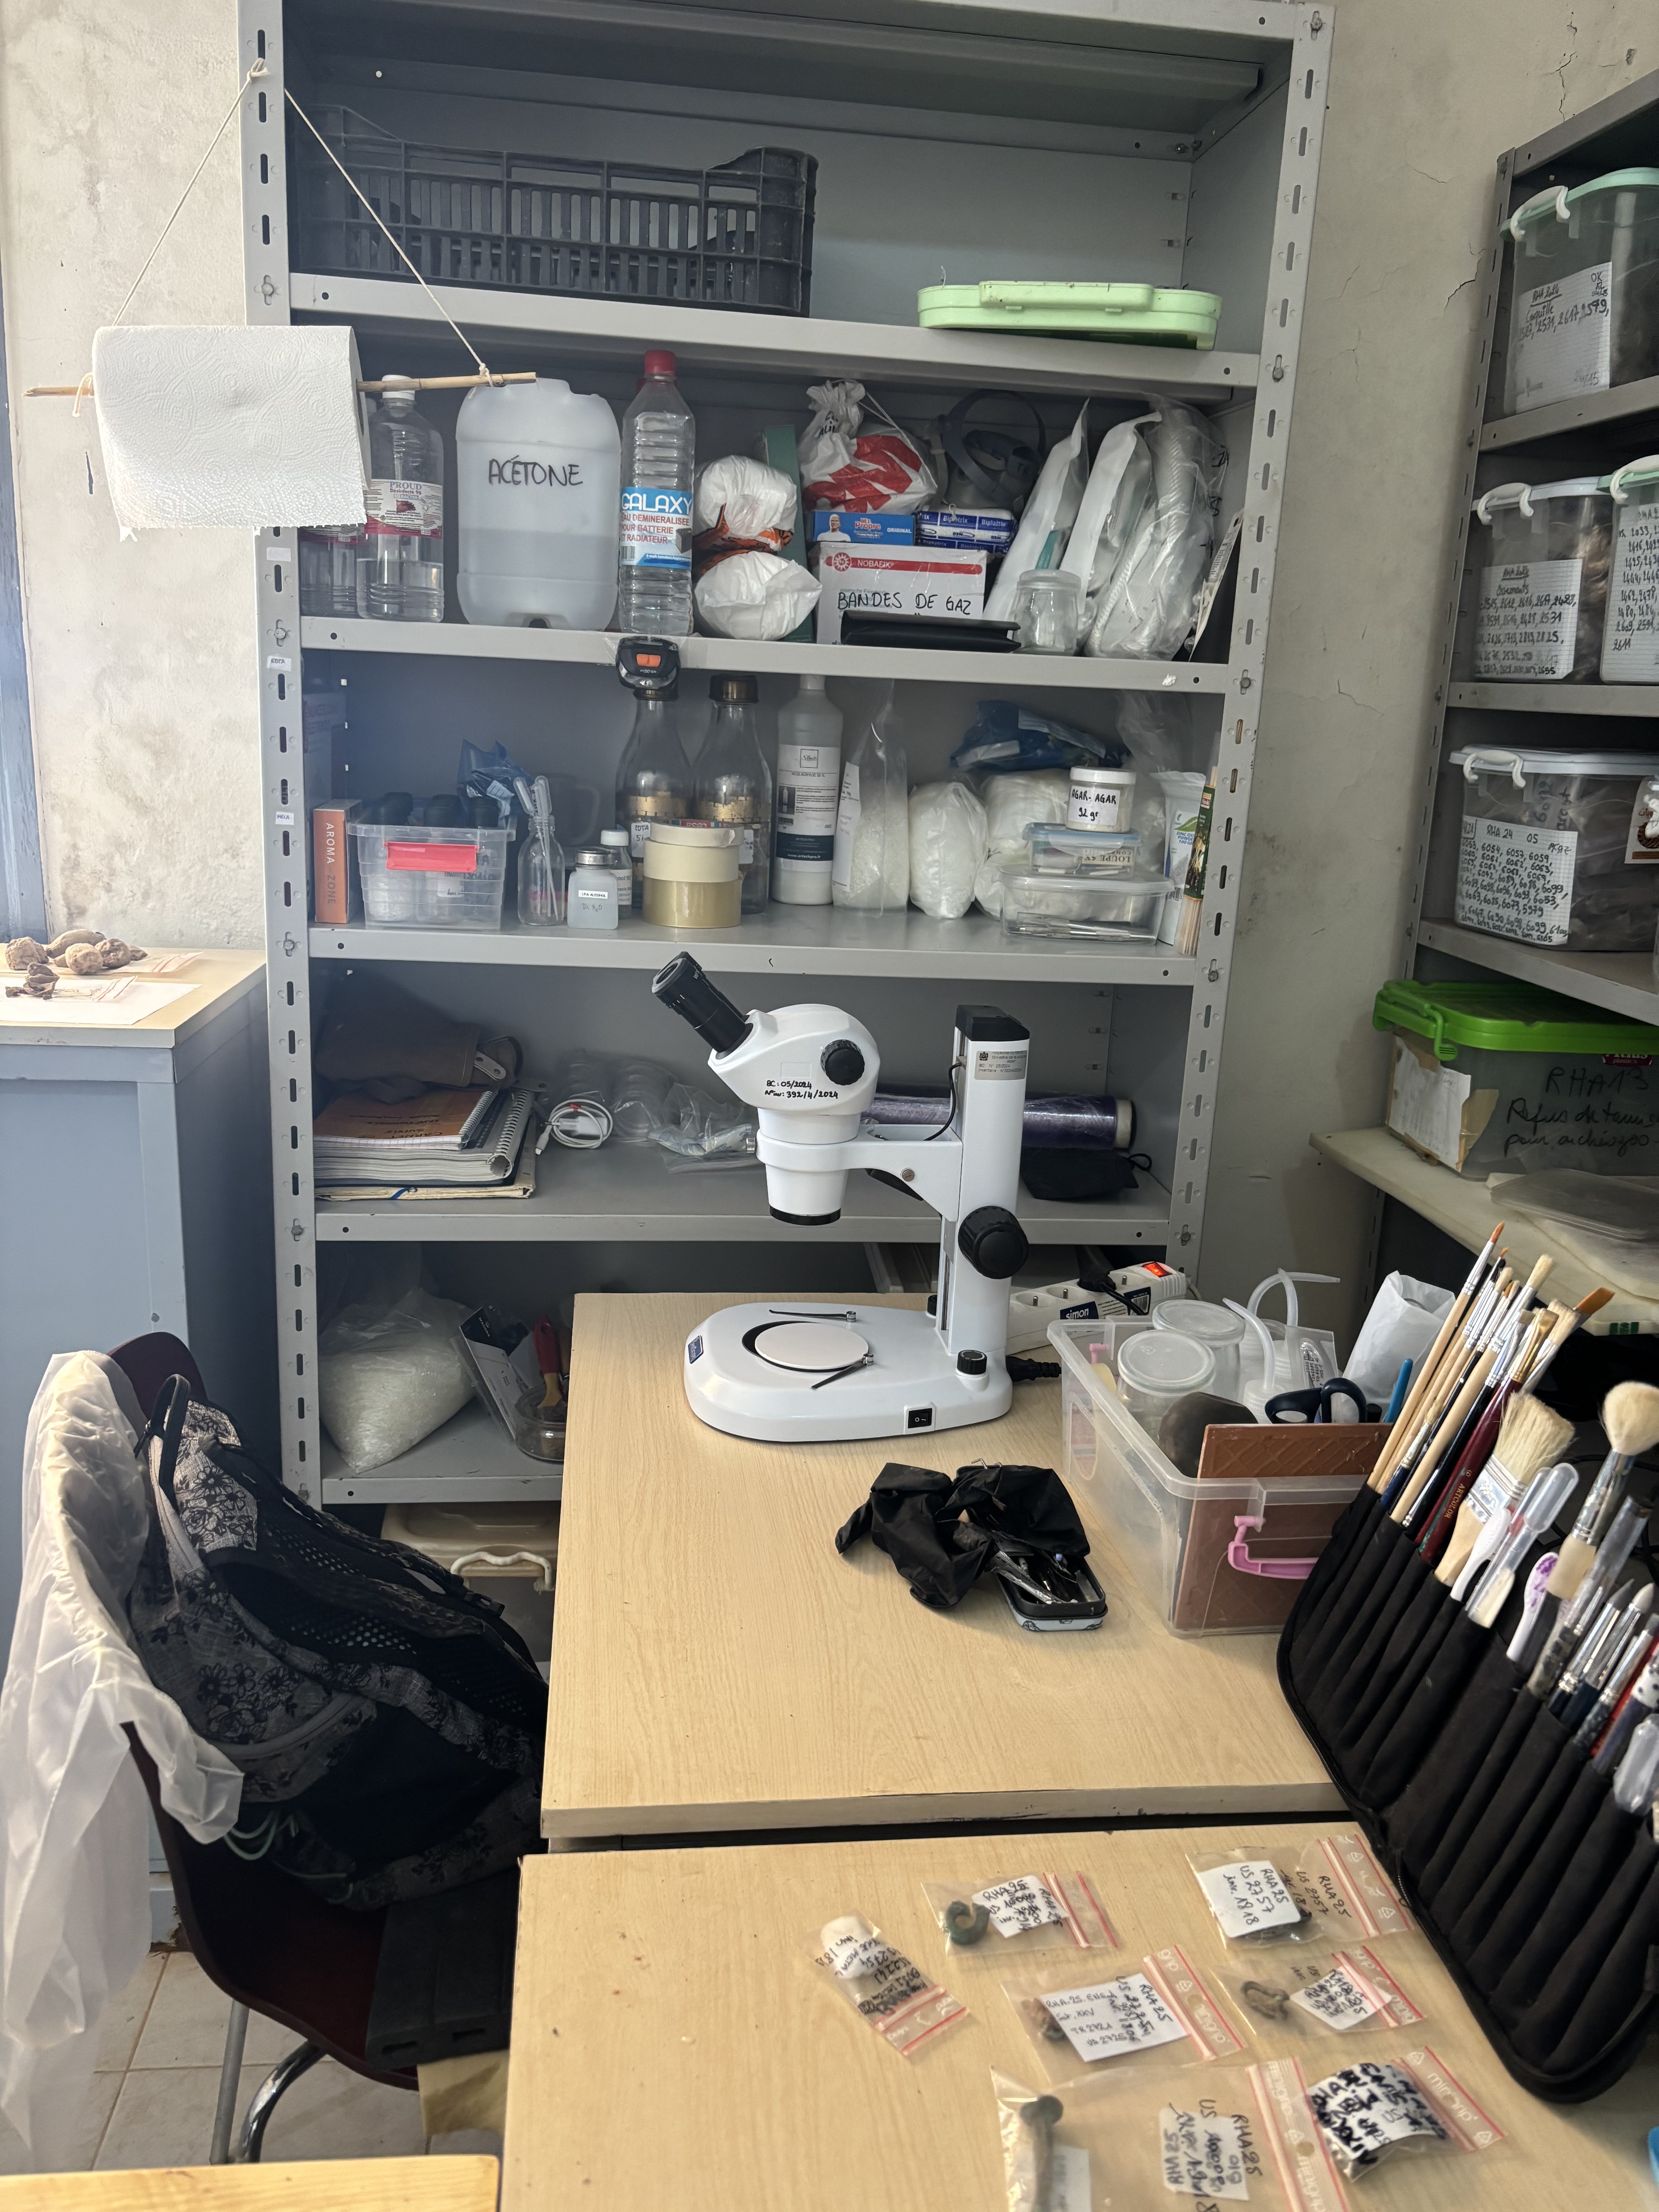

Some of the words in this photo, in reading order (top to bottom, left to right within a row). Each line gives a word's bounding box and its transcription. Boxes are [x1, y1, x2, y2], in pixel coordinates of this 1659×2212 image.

[488, 455, 583, 487] ACÉTONE
[390, 481, 422, 490] PROUD
[622, 493, 692, 515] GALAXY
[632, 514, 689, 526] DEMINERALISEE
[855, 521, 881, 530] Propre
[982, 519, 1006, 527] Biplatrix
[637, 524, 673, 534] BATTERIE
[627, 534, 668, 544] RADIATEUR
[857, 560, 891, 568] NOBAFIX
[837, 592, 902, 610] BANDES
[915, 593, 938, 609] DE
[946, 596, 971, 615] GAZ
[1095, 794, 1116, 805] AGAR
[1090, 812, 1099, 821] gr
[326, 823, 335, 864] AROMA
[1527, 833, 1539, 843] OS
[327, 874, 335, 904] ZONE
[781, 1080, 812, 1090] 05/2024
[787, 1089, 838, 1099] 392/4/2024
[1066, 1308, 1089, 1319] simon
[1444, 1483, 1465, 1519] ARTCOLOR
[1239, 1863, 1254, 1880] US
[1260, 1866, 1279, 1891] RHA
[1271, 1887, 1290, 1906] 25
[1245, 1876, 1275, 1917] 2757
[1234, 1893, 1260, 1927] 1818
[1199, 2099, 1217, 2118] US
[1231, 2114, 1252, 2149] RHA
